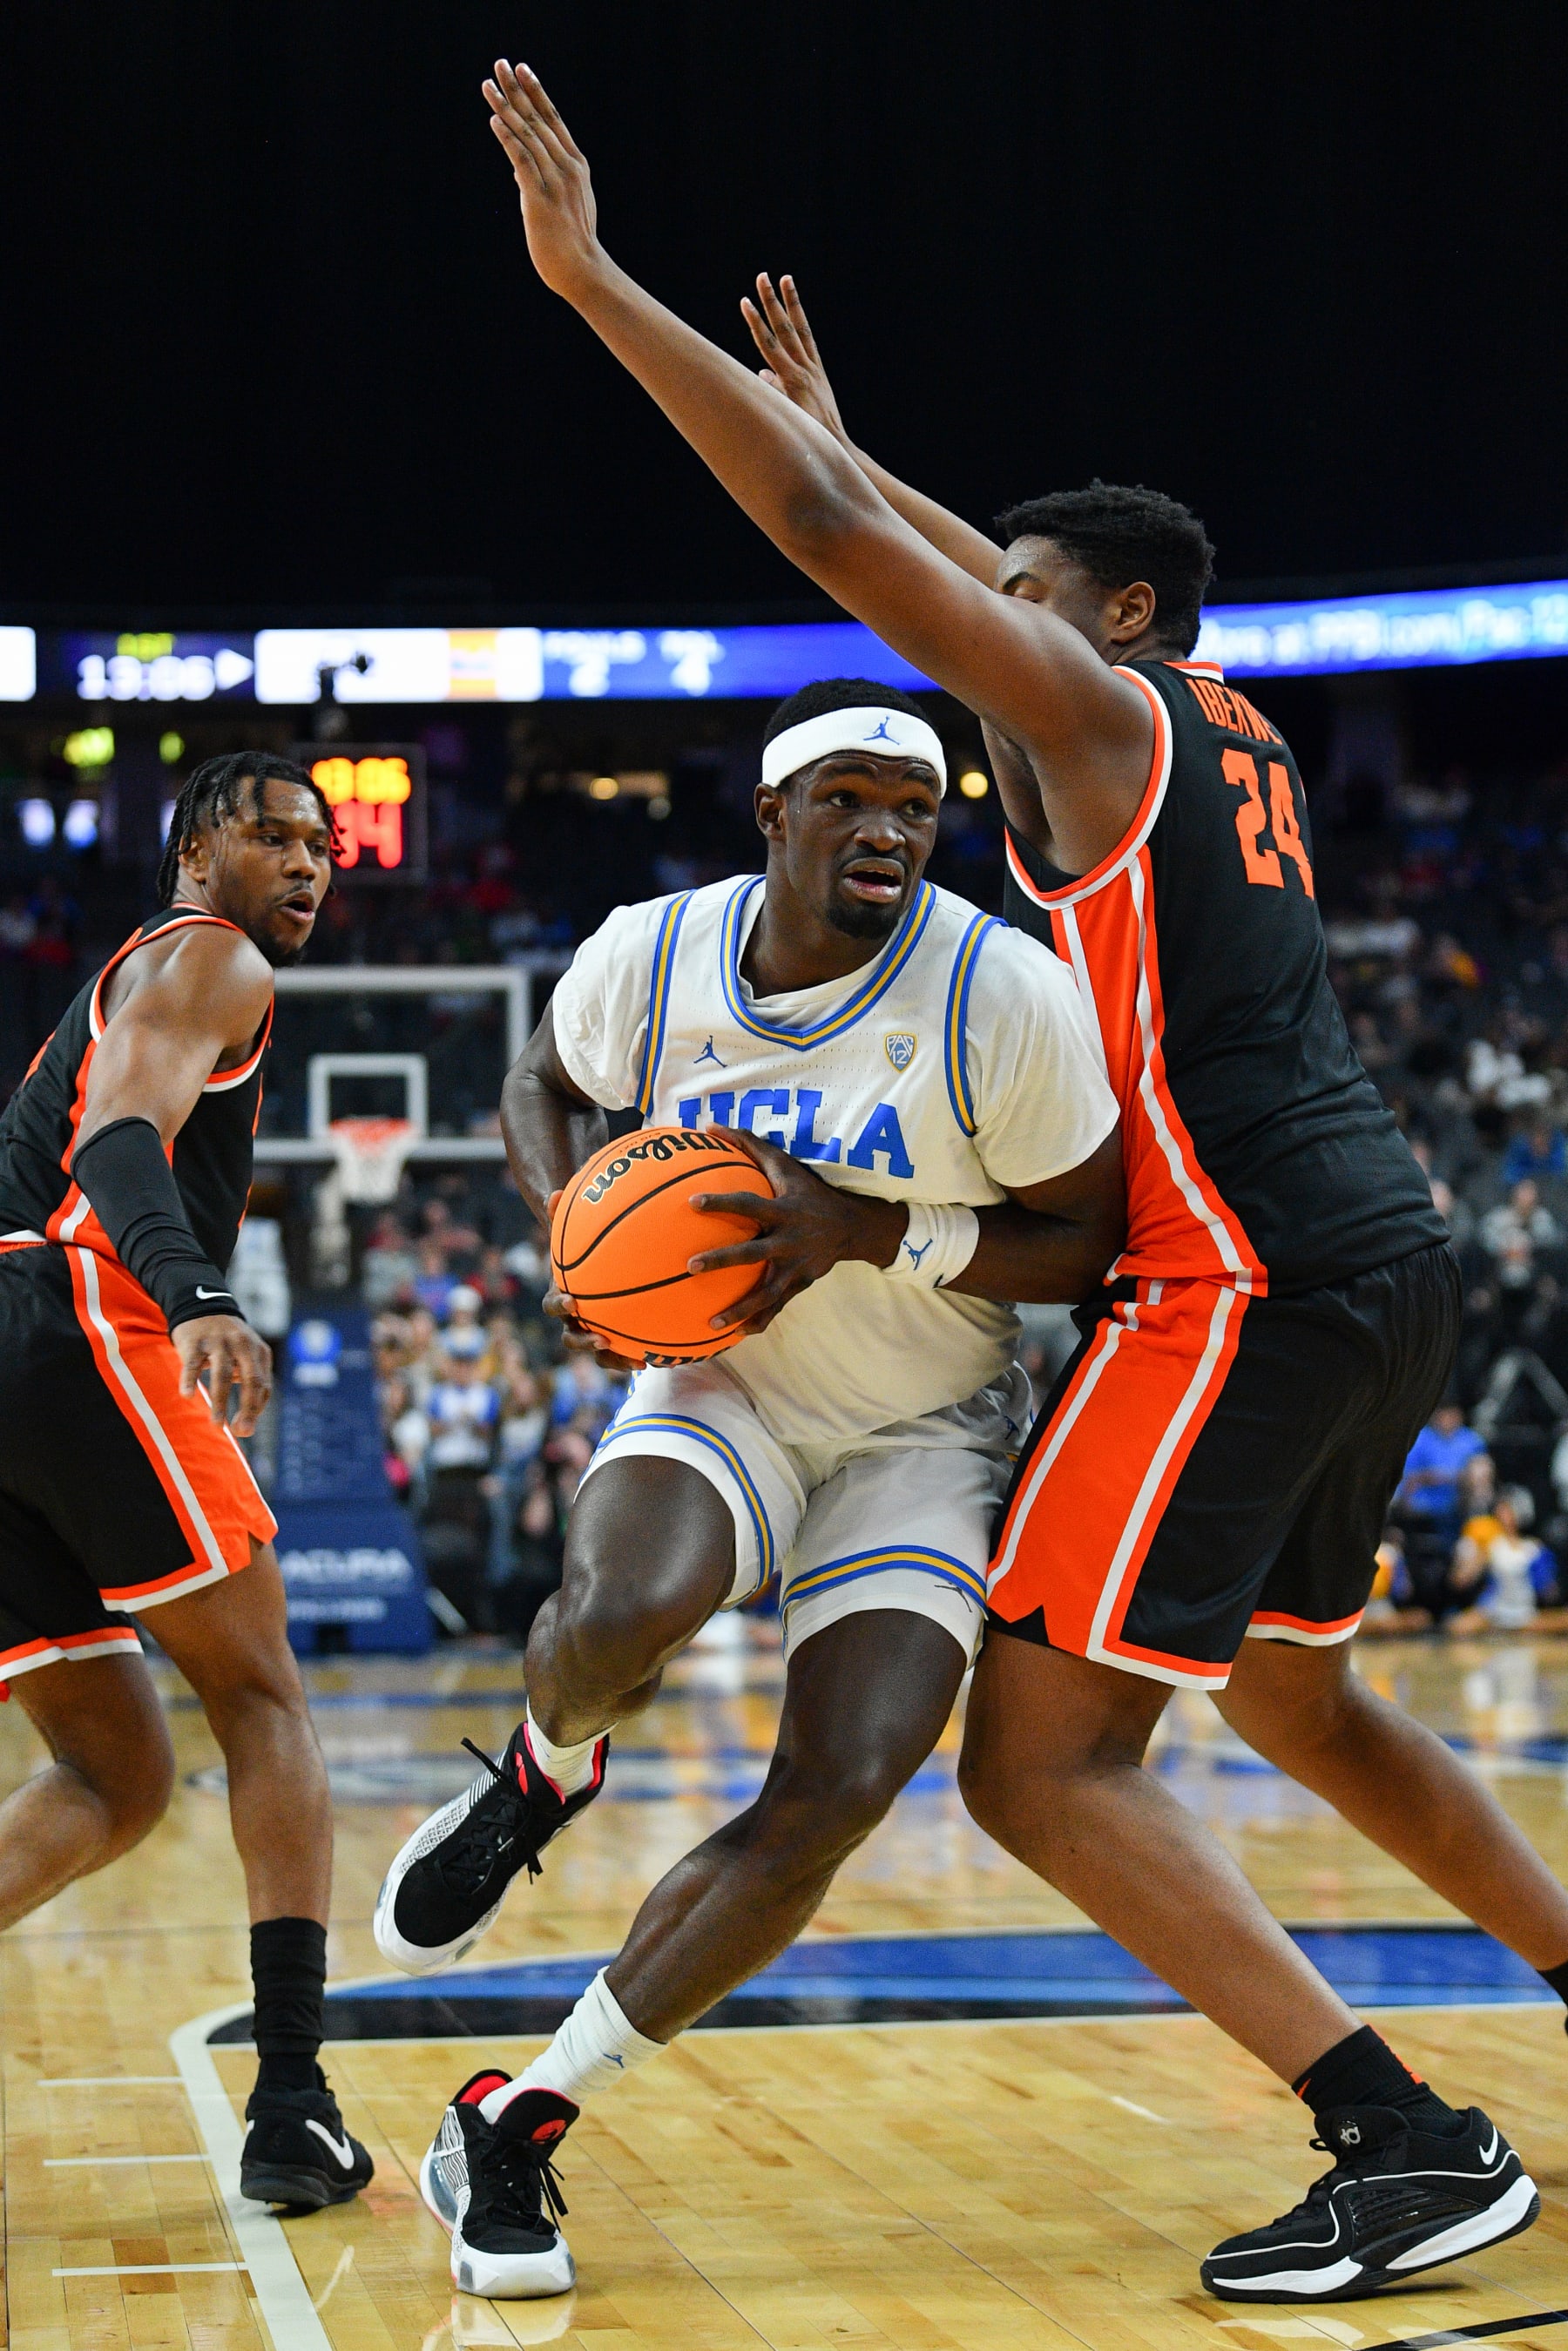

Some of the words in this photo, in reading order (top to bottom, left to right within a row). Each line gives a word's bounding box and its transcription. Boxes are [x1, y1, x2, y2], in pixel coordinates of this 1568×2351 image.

[1221, 748, 1315, 901] 24
[887, 1035, 914, 1057] PAC
[893, 1051, 907, 1064] 12
[582, 1132, 734, 1204] Wilson
